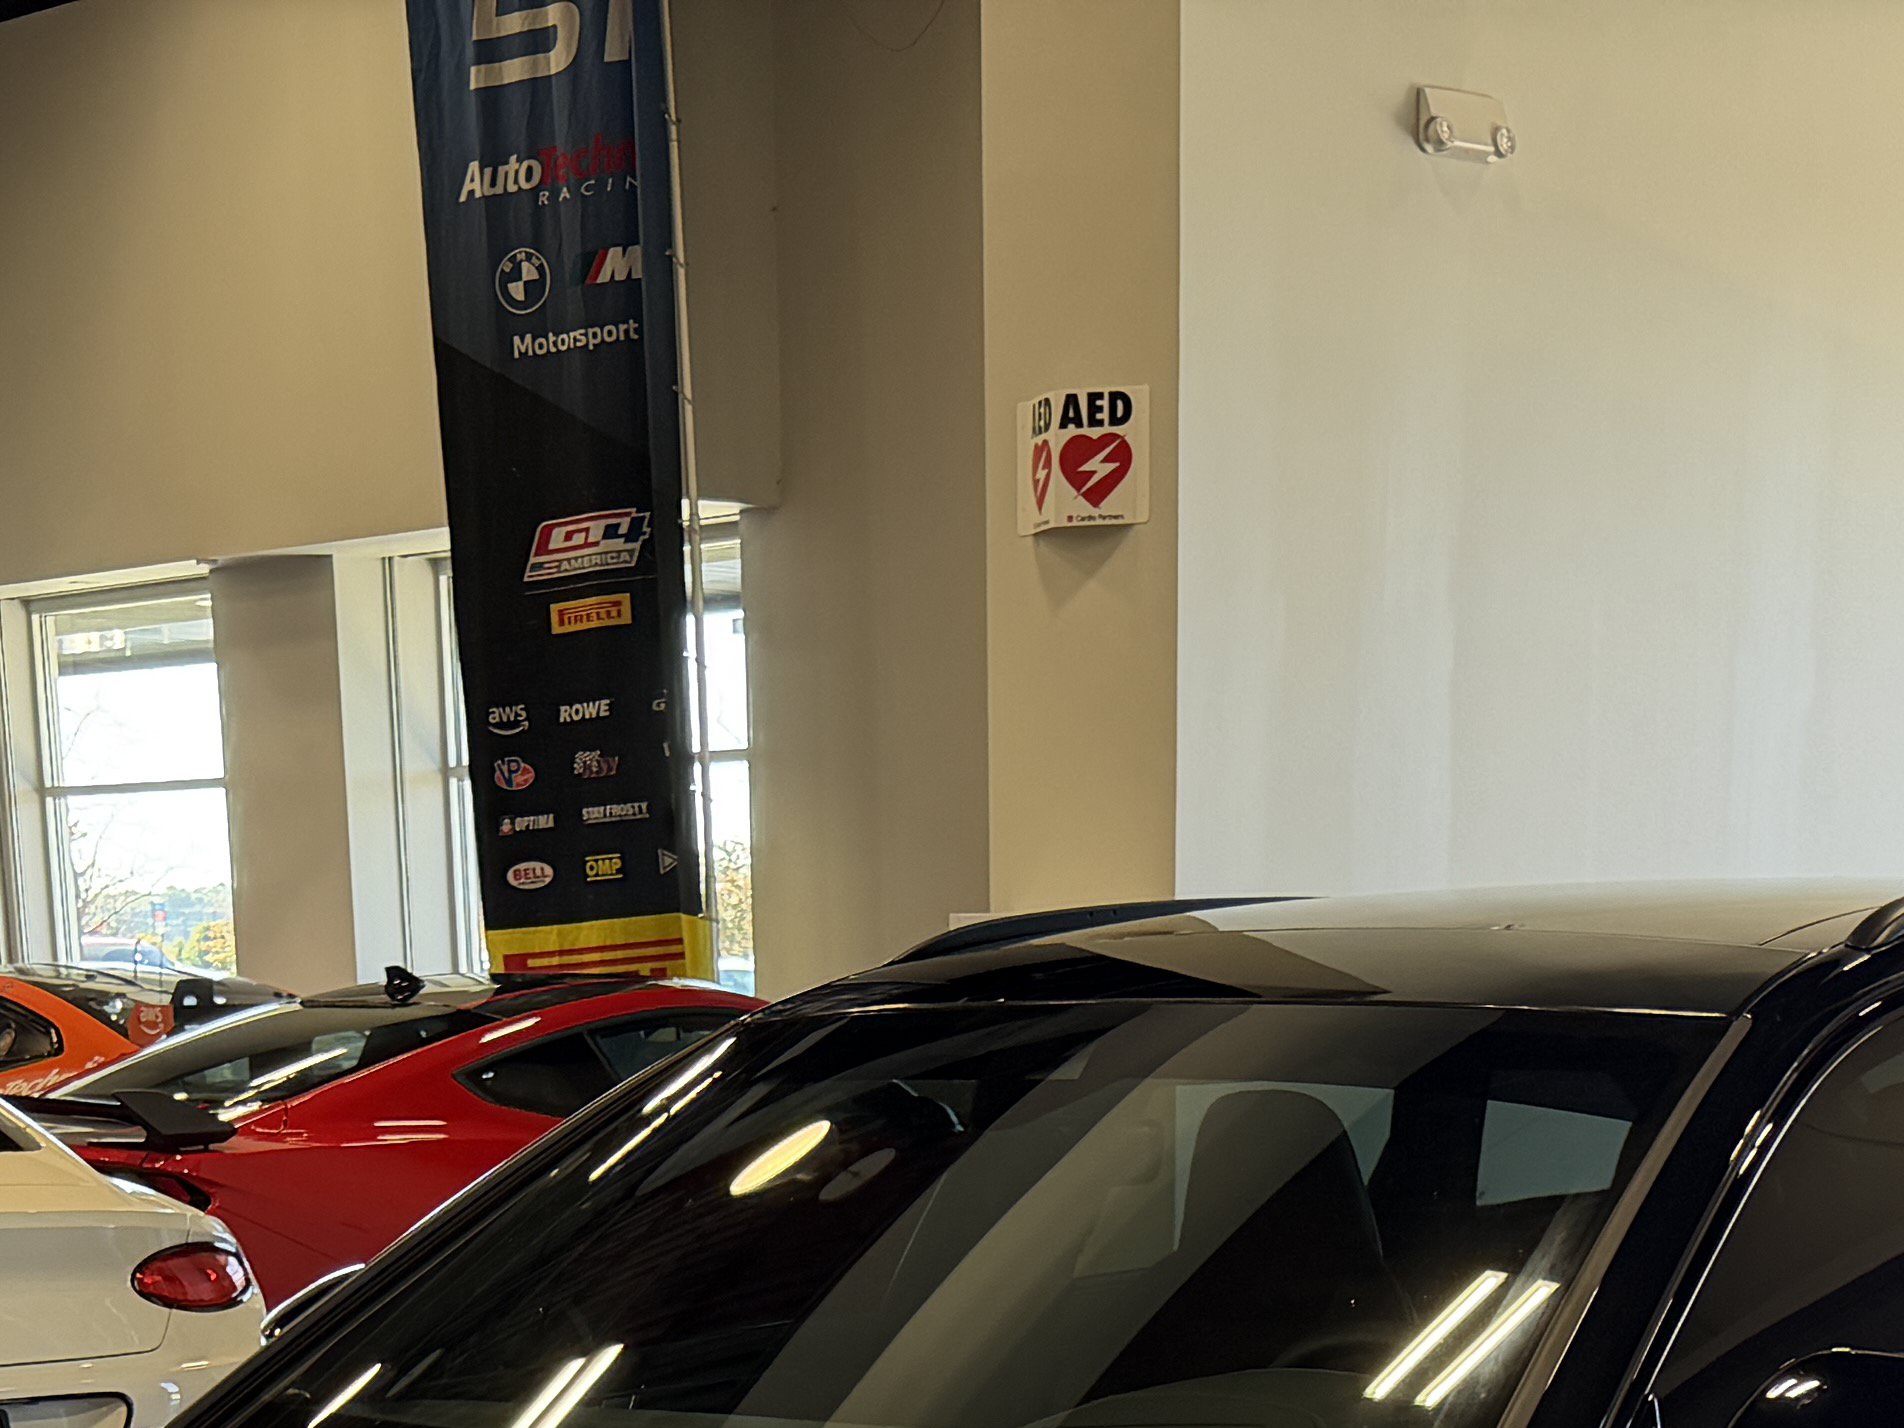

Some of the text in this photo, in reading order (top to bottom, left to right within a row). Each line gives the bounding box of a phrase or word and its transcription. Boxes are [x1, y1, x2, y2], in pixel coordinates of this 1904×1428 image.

[513, 319, 639, 359] Motorsport
[1058, 390, 1133, 430] AED
[547, 514, 649, 551] GT4
[559, 551, 632, 572] AMERICA
[557, 600, 623, 627] PIRELLI
[488, 703, 527, 723] aws
[559, 699, 611, 723] ROWE
[494, 756, 523, 788] VP
[582, 801, 649, 820] STAY FROSTY
[514, 813, 555, 831] OPTIMA
[512, 865, 551, 881] BELL
[586, 858, 622, 876] OMP
